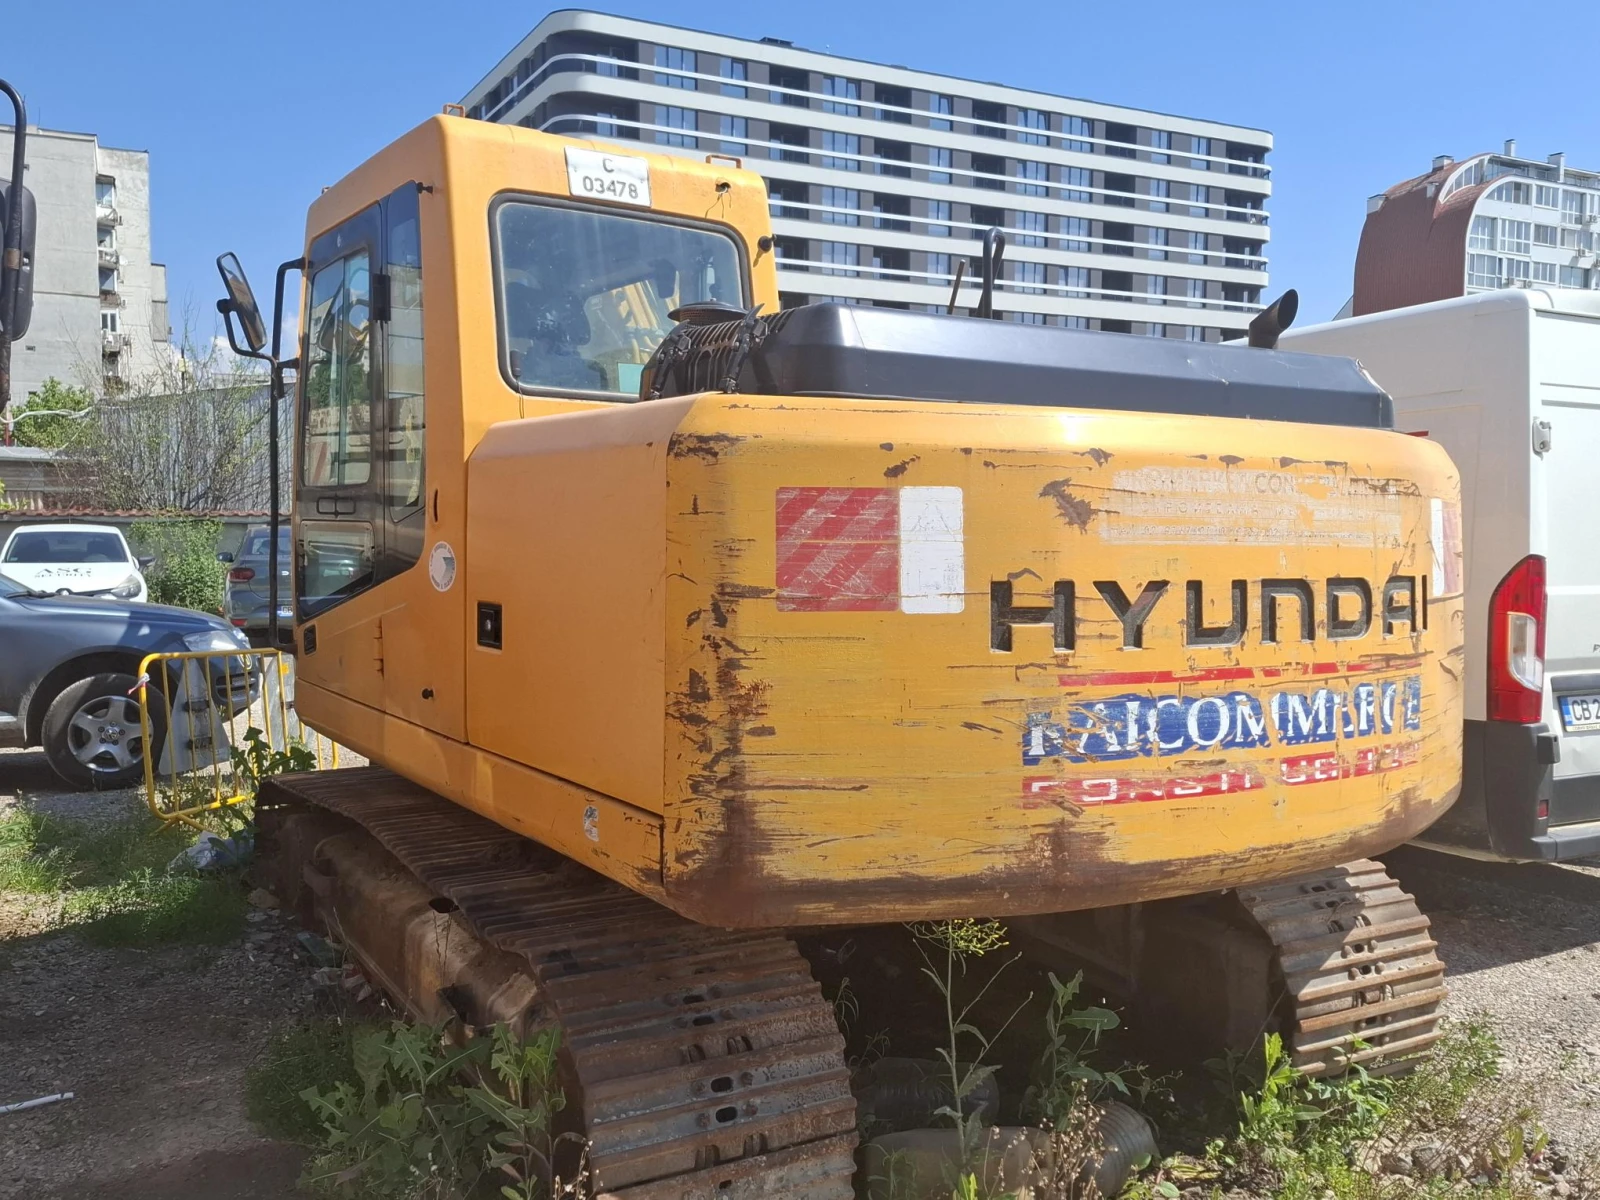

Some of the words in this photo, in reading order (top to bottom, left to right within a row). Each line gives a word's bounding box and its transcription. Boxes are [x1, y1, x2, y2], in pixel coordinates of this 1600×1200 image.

[602, 158, 615, 173] C
[582, 175, 639, 200] 03478
[988, 573, 1428, 654] HYUNDAI
[1571, 699, 1592, 721] CB
